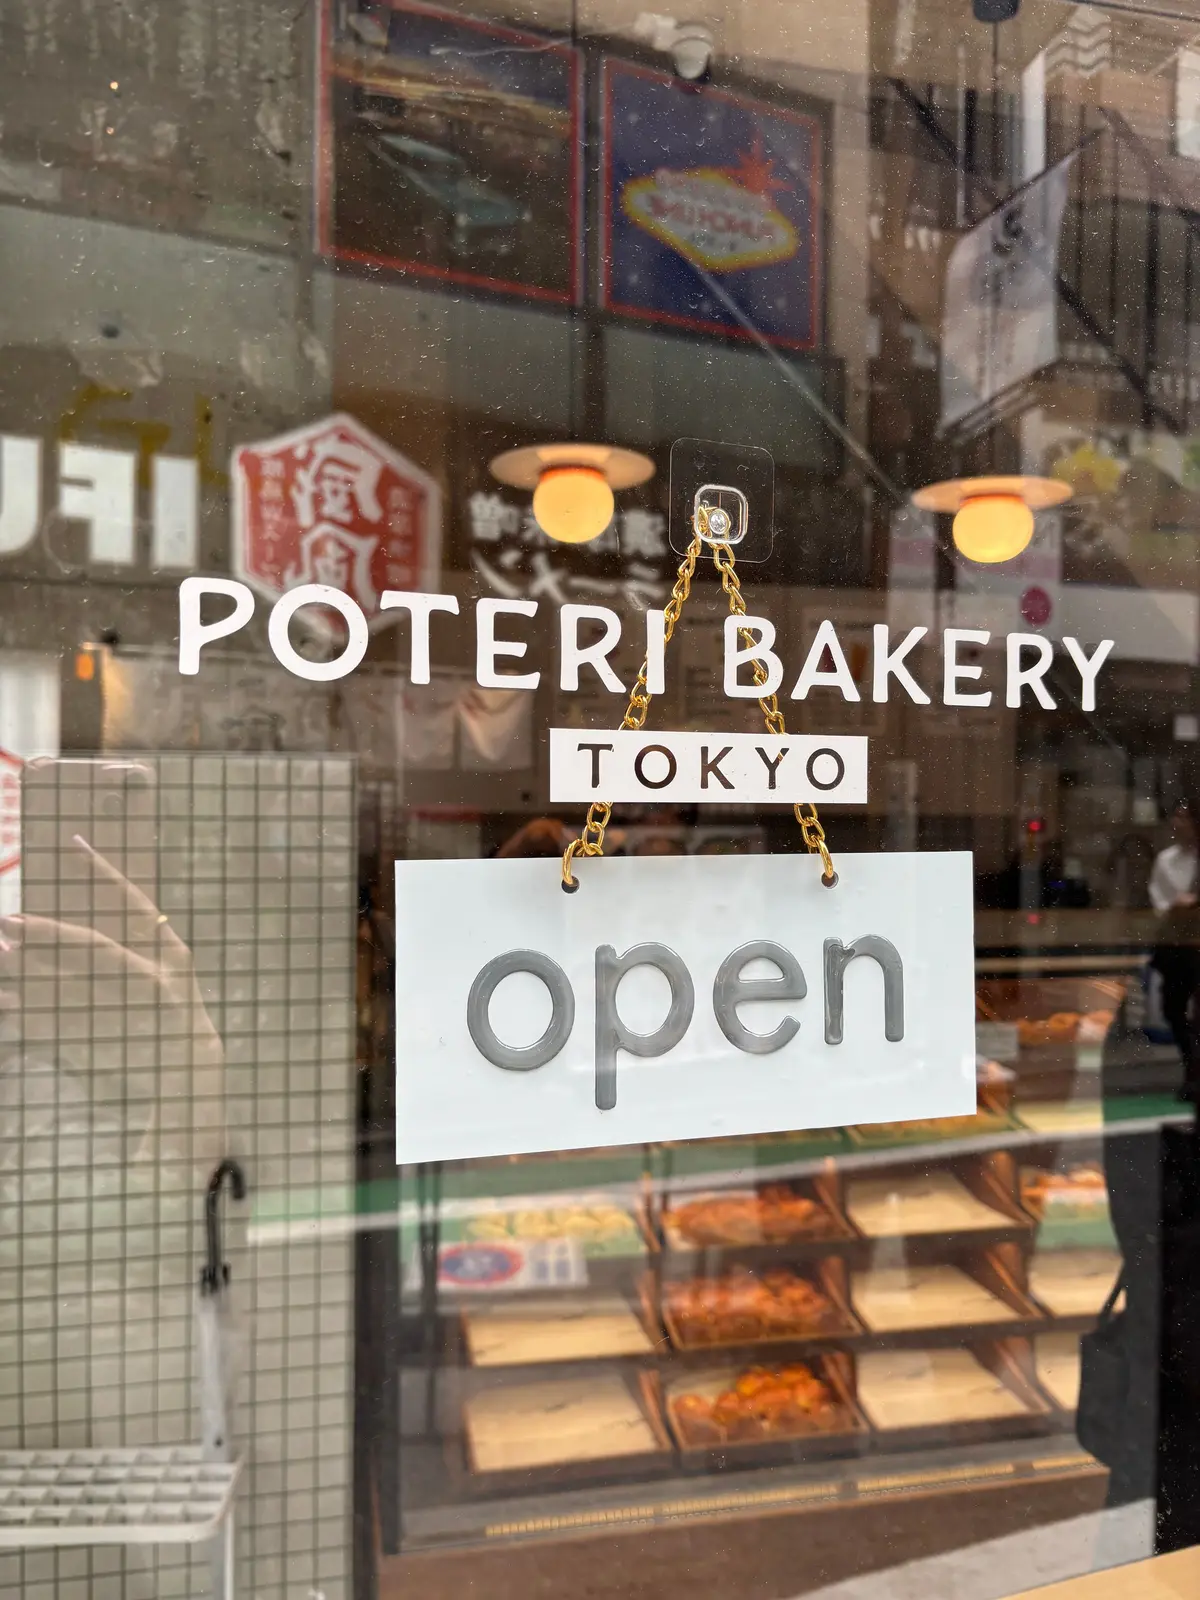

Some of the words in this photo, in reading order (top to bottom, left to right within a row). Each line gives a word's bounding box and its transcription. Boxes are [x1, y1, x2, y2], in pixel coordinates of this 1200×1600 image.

[178, 577, 665, 695] POTERI
[723, 614, 1115, 712] BAKERY
[577, 743, 845, 791] TOKYO
[466, 933, 905, 1111] open
